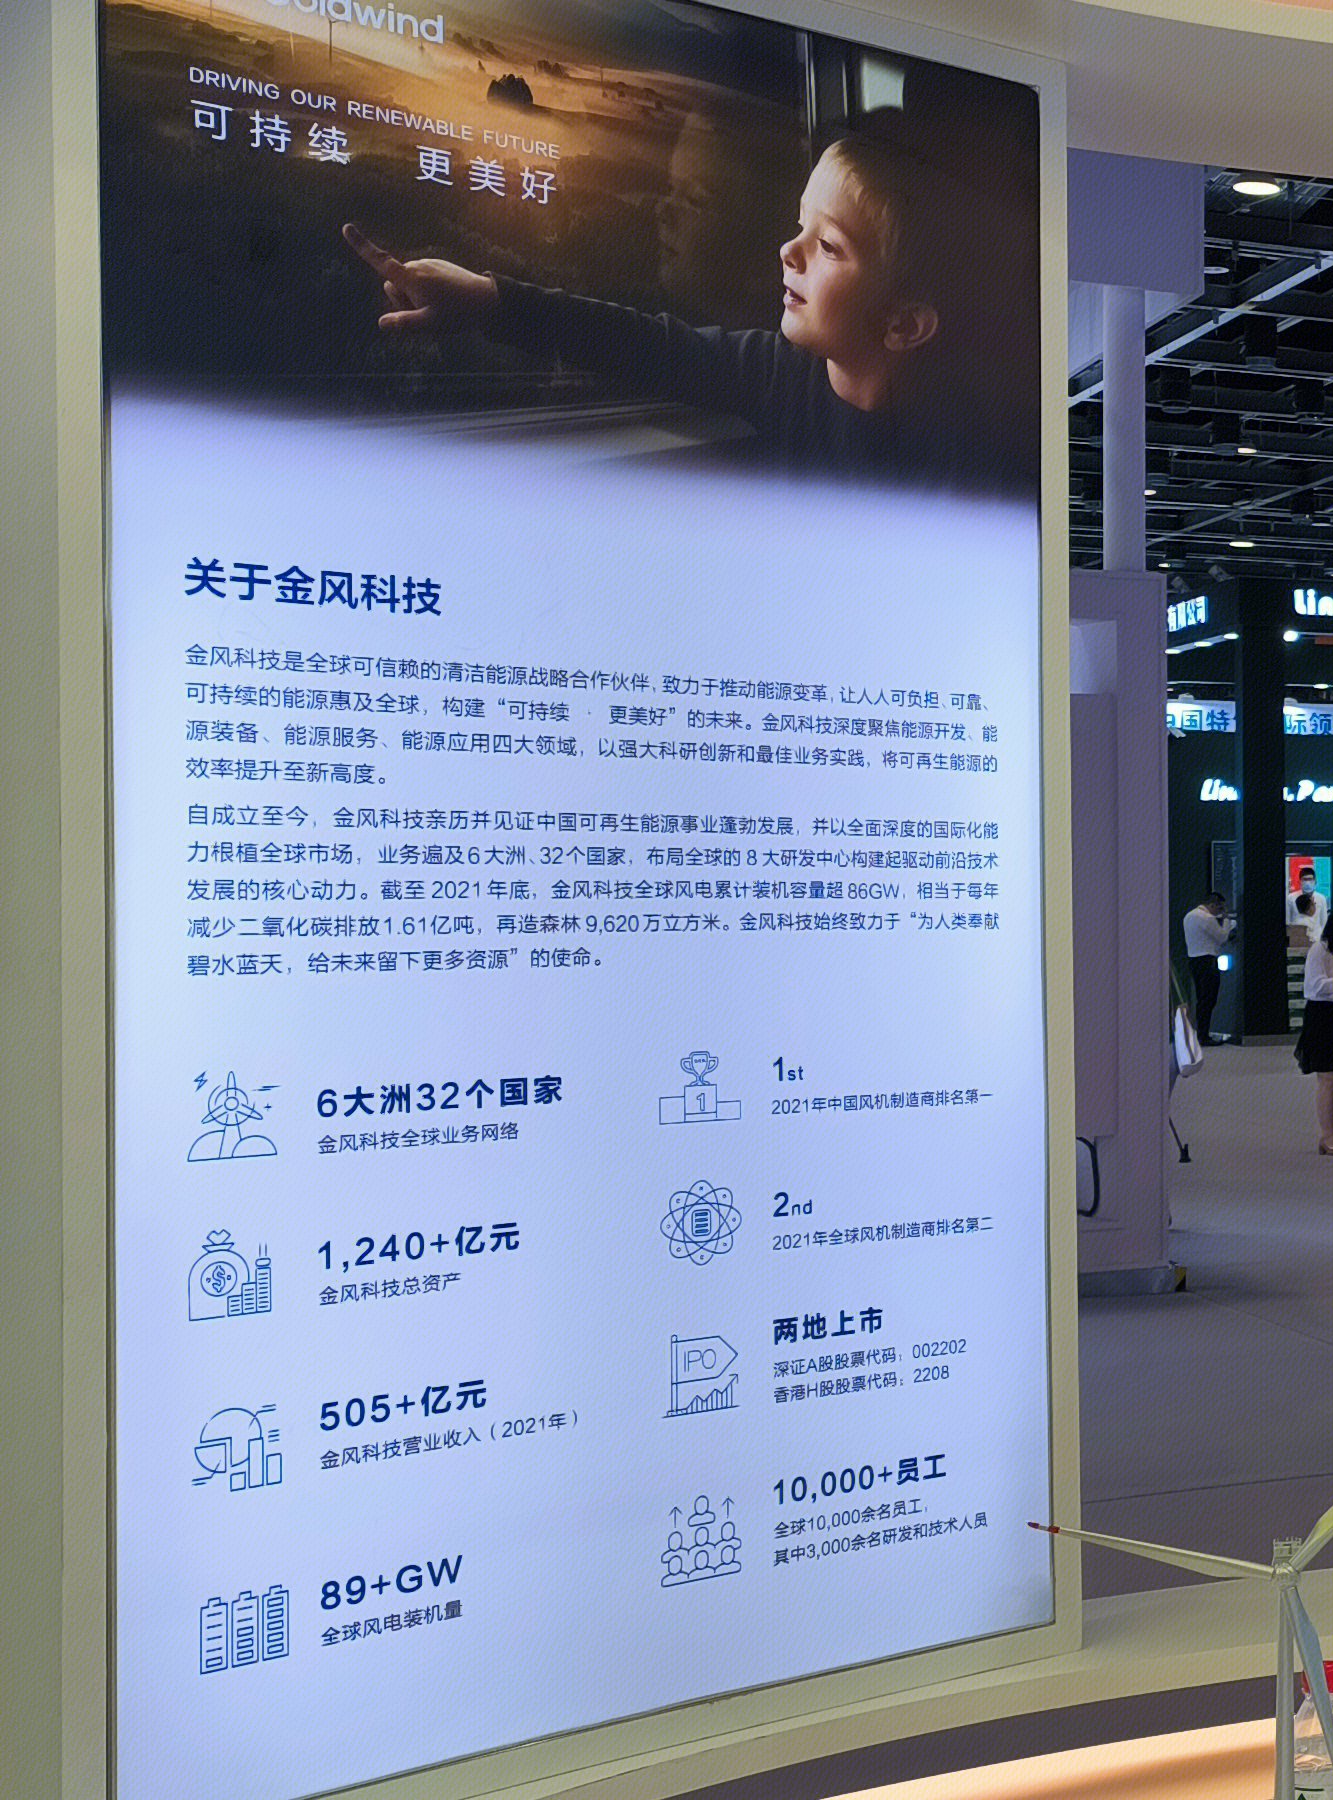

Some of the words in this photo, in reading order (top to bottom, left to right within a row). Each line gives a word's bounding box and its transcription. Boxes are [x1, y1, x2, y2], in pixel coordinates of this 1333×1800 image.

[264, 0, 444, 44] oldwind
[189, 66, 280, 99] DRIVING
[291, 88, 337, 111] OUR
[347, 100, 473, 142] RENEWABLE
[483, 130, 560, 159] FUTURE
[190, 99, 351, 165] 可持续
[416, 145, 557, 204] 更美好
[184, 557, 442, 616] 关于金风科技
[185, 756, 390, 786] 效率提升至新高度。
[772, 1056, 804, 1082] 1st
[316, 1074, 563, 1118] 6大洲32个国家
[771, 1088, 994, 1115] 2021年中国风机制造商排名第一
[317, 1121, 519, 1155] 金风科技全球业务网络
[772, 1191, 813, 1218] 2nd
[317, 1222, 520, 1274] 1,240+亿元
[318, 1272, 461, 1307] 金风科技总资产
[772, 1307, 883, 1345] 两地上市
[683, 1348, 717, 1374] IPO
[319, 1379, 487, 1431] 505+亿元
[773, 1453, 947, 1505] 10,000+员工
[320, 1554, 463, 1610] 89+GW
[321, 1599, 463, 1647] 全球风电装机量
